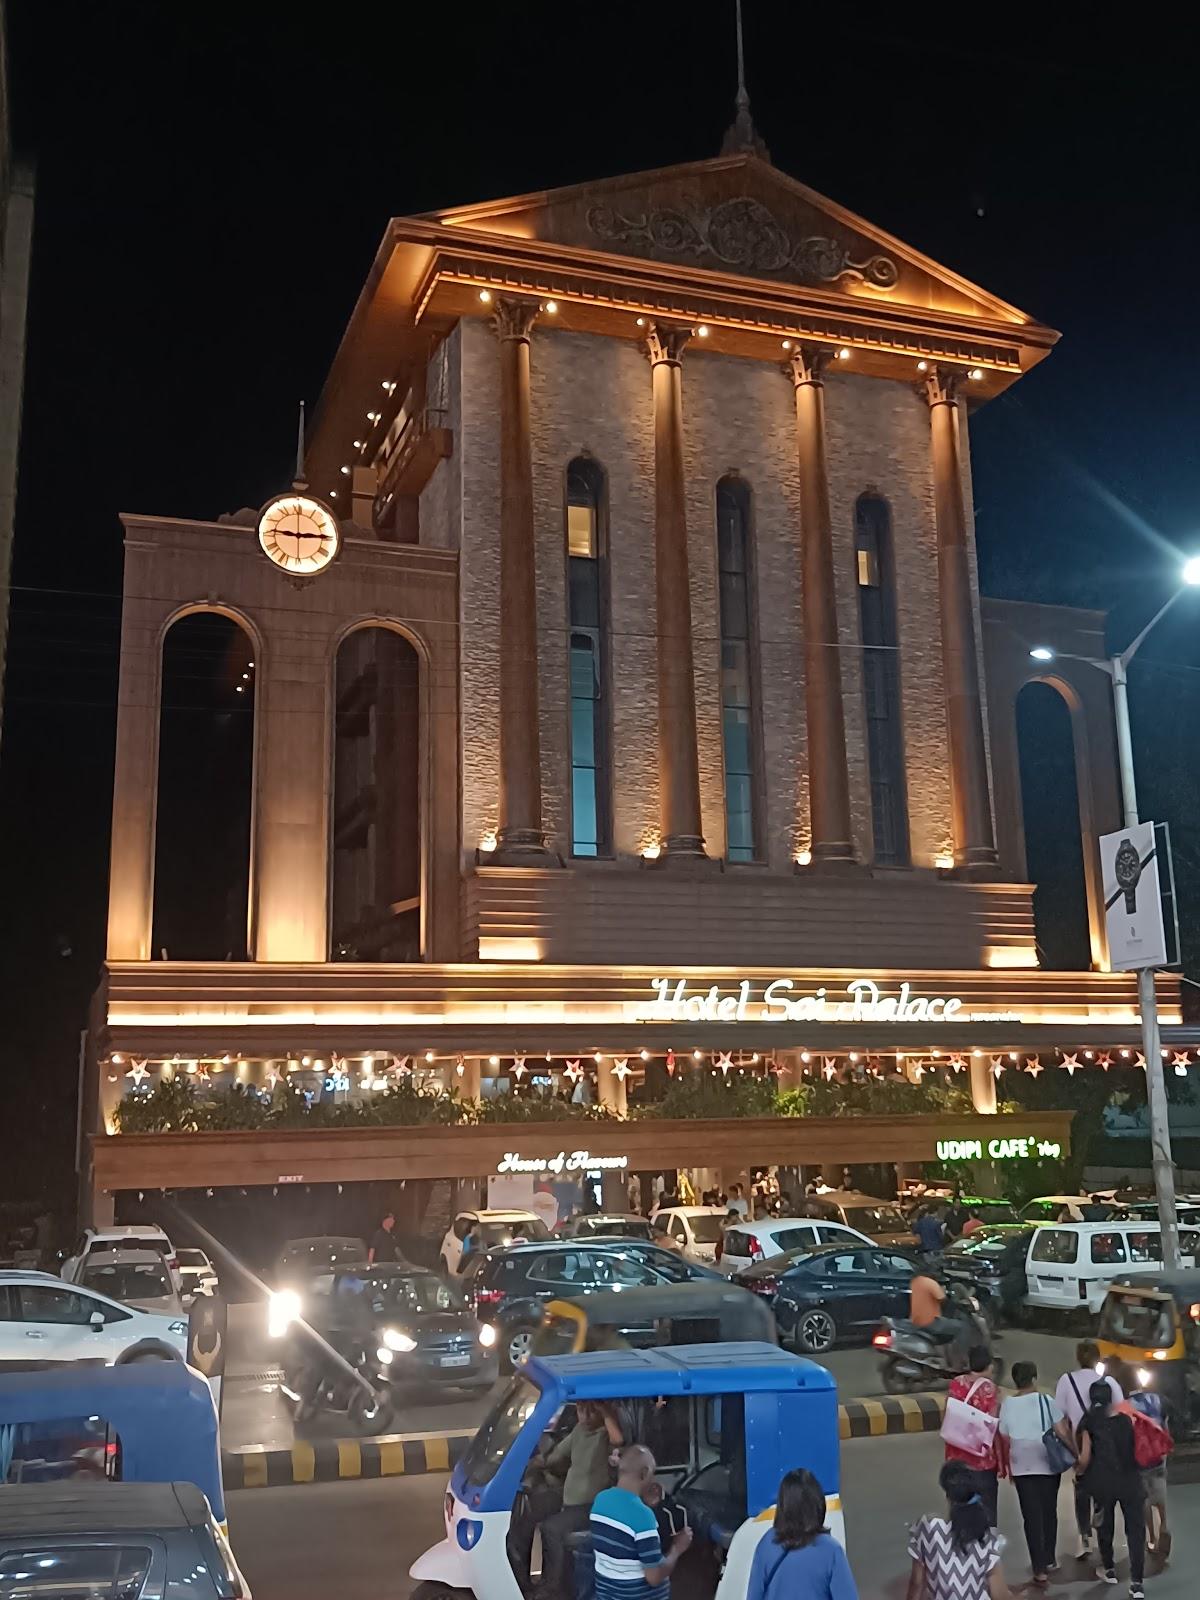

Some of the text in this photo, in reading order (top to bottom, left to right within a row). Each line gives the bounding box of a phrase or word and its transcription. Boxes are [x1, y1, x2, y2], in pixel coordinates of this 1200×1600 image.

[651, 979, 963, 1021] Hotel Sai Palace
[936, 1140, 982, 1160] UDIPI
[548, 1152, 564, 1174] of
[279, 1175, 303, 1184] EXIT
